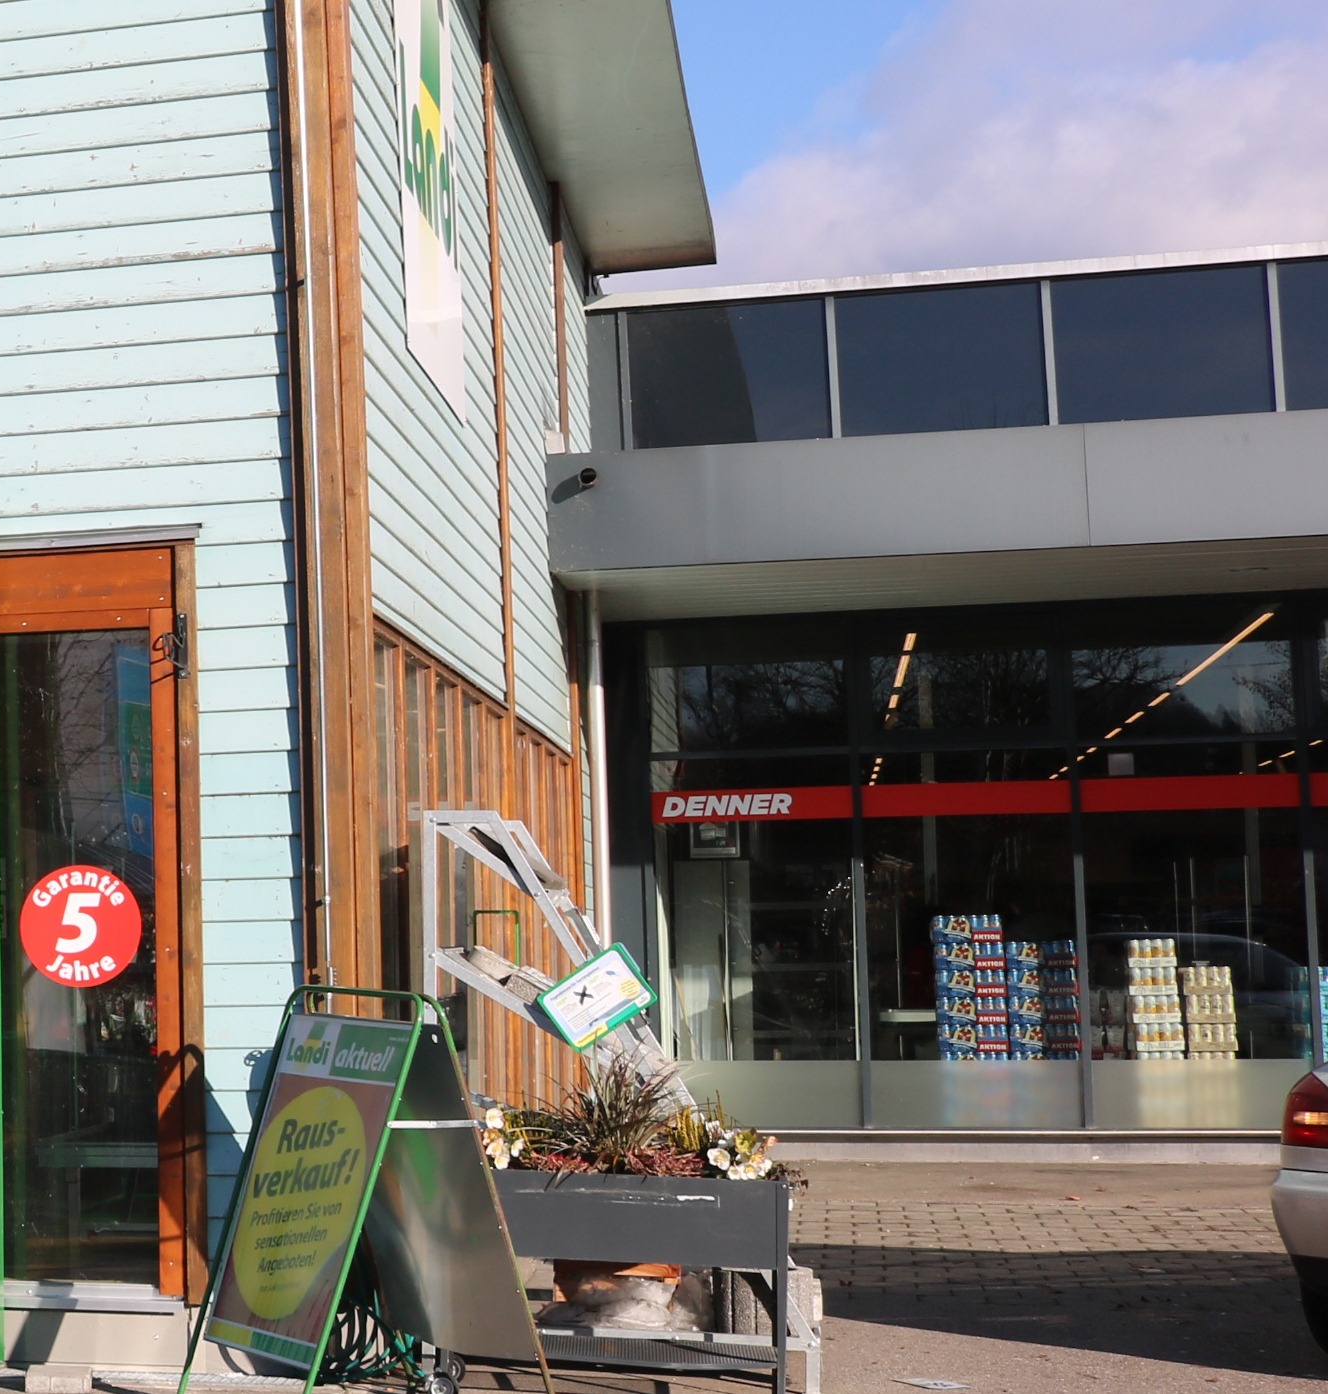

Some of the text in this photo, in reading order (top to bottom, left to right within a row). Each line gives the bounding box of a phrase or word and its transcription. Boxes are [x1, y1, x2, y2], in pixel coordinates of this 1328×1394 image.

[399, 38, 459, 273] Landi
[662, 793, 793, 817] DENNER
[32, 871, 125, 907] Garantie
[55, 892, 101, 953] 5
[973, 933, 1001, 941] AKTION
[45, 954, 117, 981] Jahre
[978, 1015, 1006, 1023] AKTION
[286, 1037, 395, 1072] Landi aktuell
[979, 1043, 1007, 1051] AKTION
[276, 1118, 346, 1154] Raus-
[253, 1149, 360, 1199] verkauf!
[250, 1202, 342, 1227] Profitieren Sie von
[254, 1227, 328, 1250] sensationellen
[256, 1251, 317, 1276] Angeboten!
